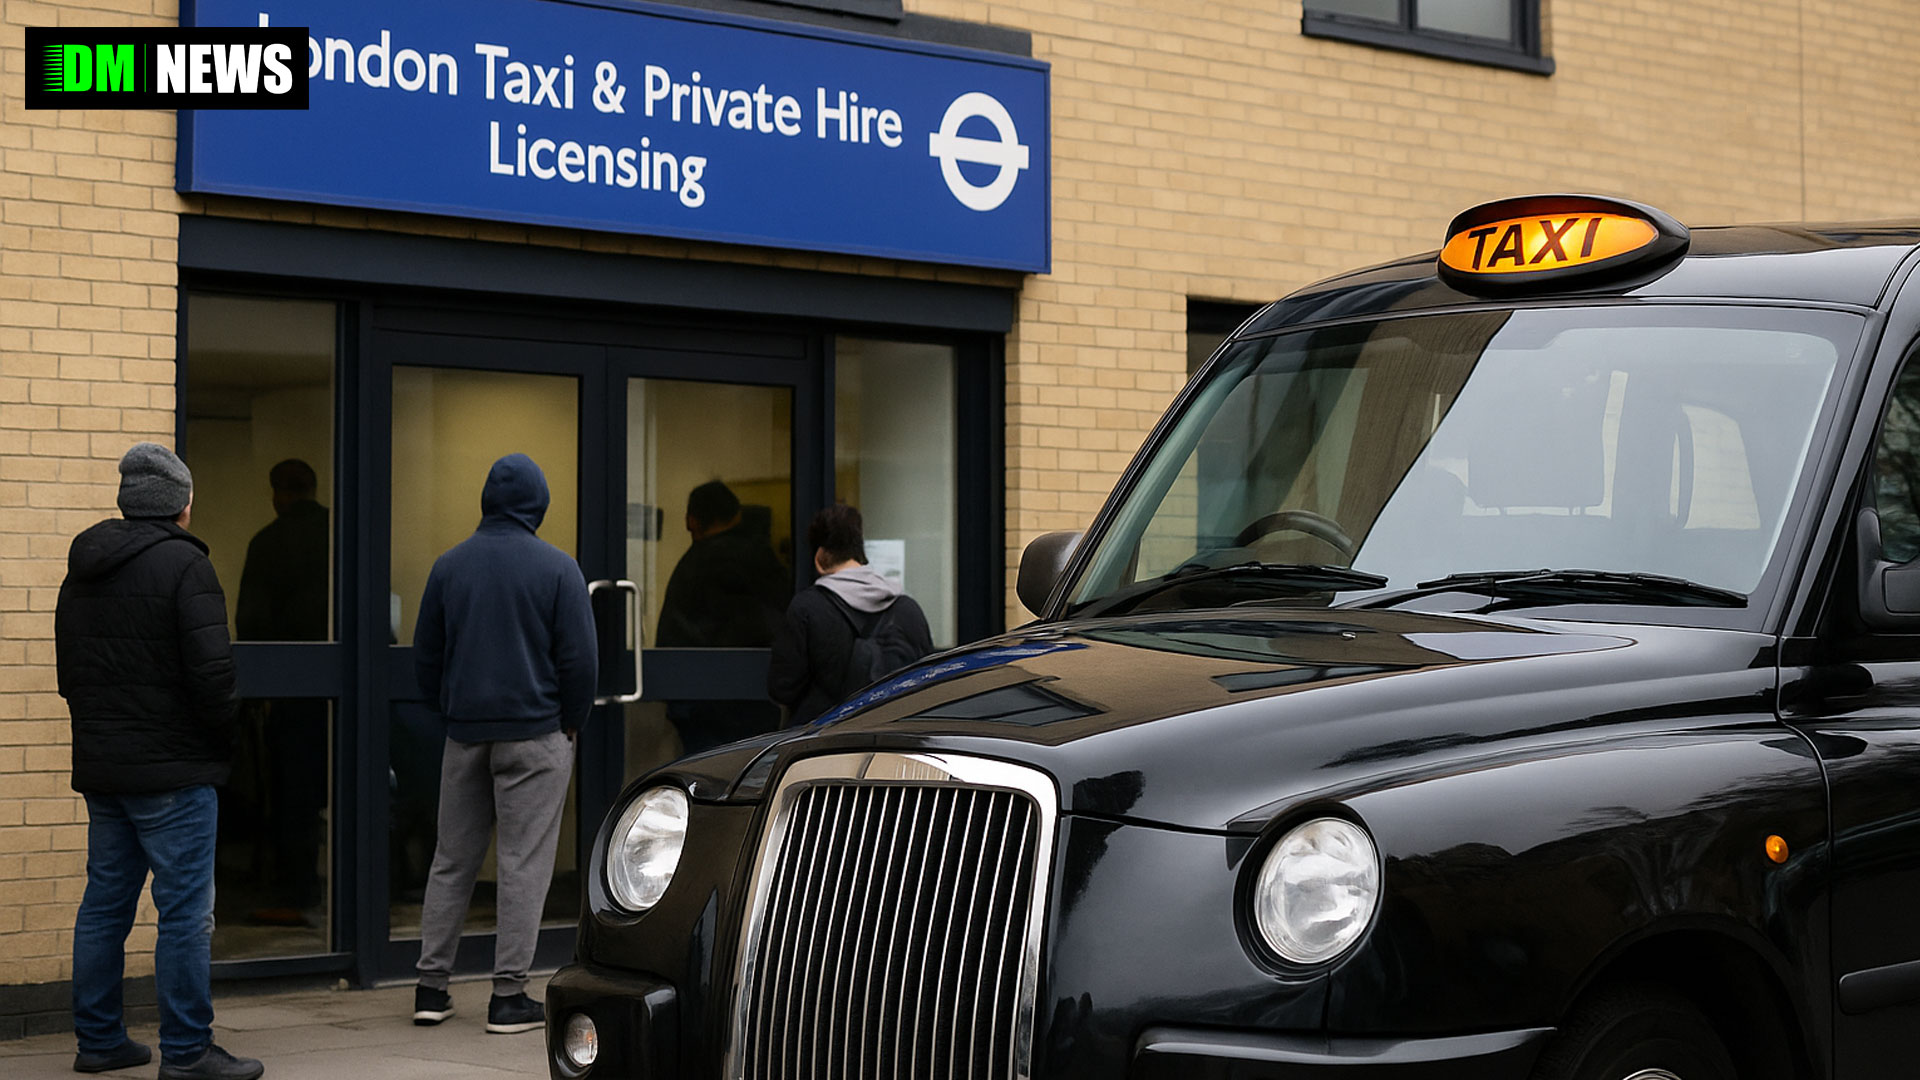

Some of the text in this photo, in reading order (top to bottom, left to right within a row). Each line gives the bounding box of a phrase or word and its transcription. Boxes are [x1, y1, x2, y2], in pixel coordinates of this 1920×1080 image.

[258, 13, 903, 148] ndon Taxi & Private Hire
[490, 121, 707, 208] Licensing
[1467, 217, 1602, 271] TAXI
